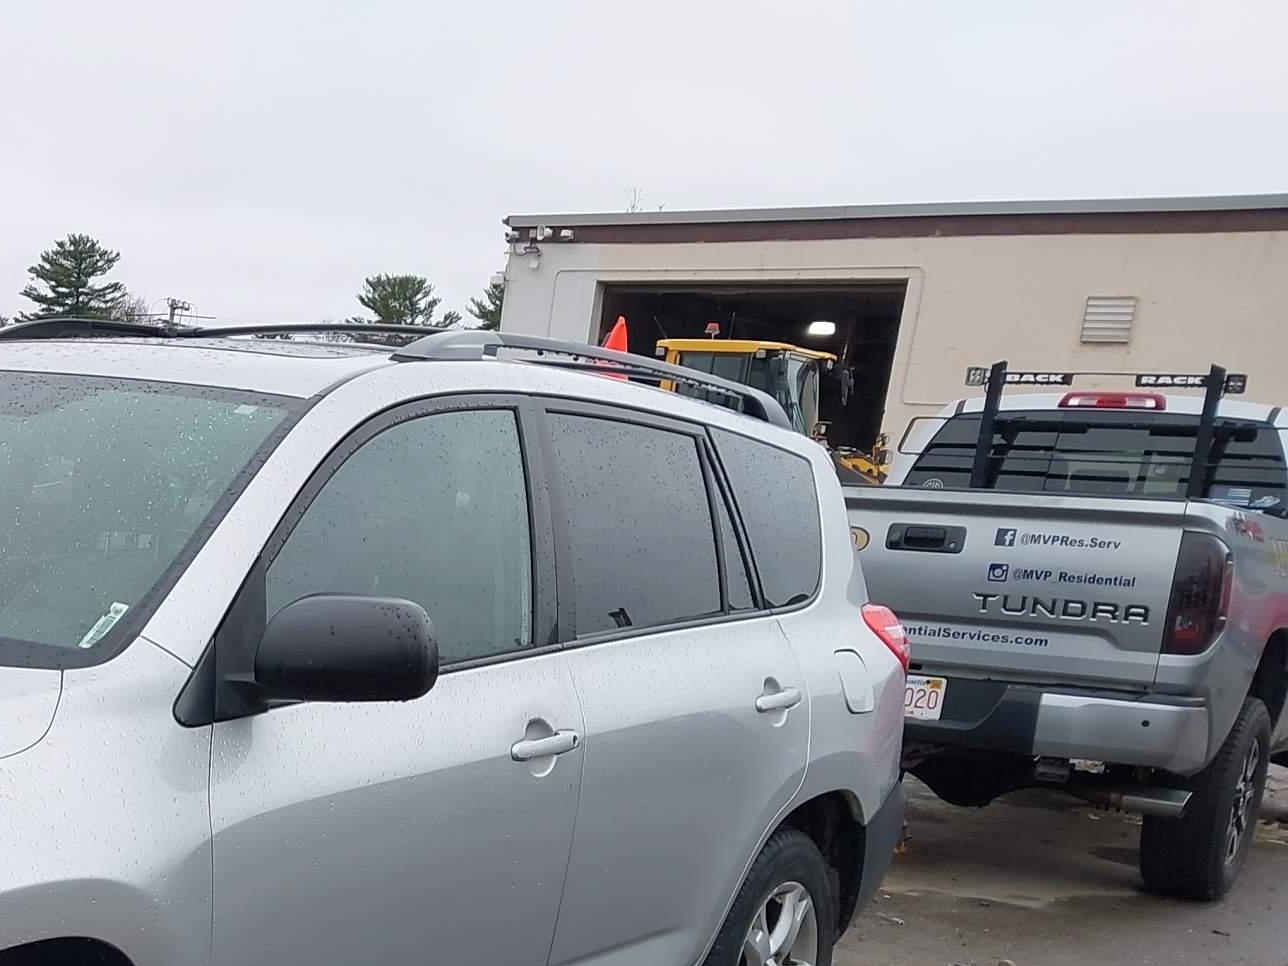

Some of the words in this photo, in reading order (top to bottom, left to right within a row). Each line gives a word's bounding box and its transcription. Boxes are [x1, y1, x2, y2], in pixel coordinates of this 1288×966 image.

[1005, 373, 1065, 383] BACK
[1140, 375, 1204, 385] RACK
[1020, 533, 1121, 550] @MVPRes.Serv
[972, 592, 1151, 626] TUNDRA
